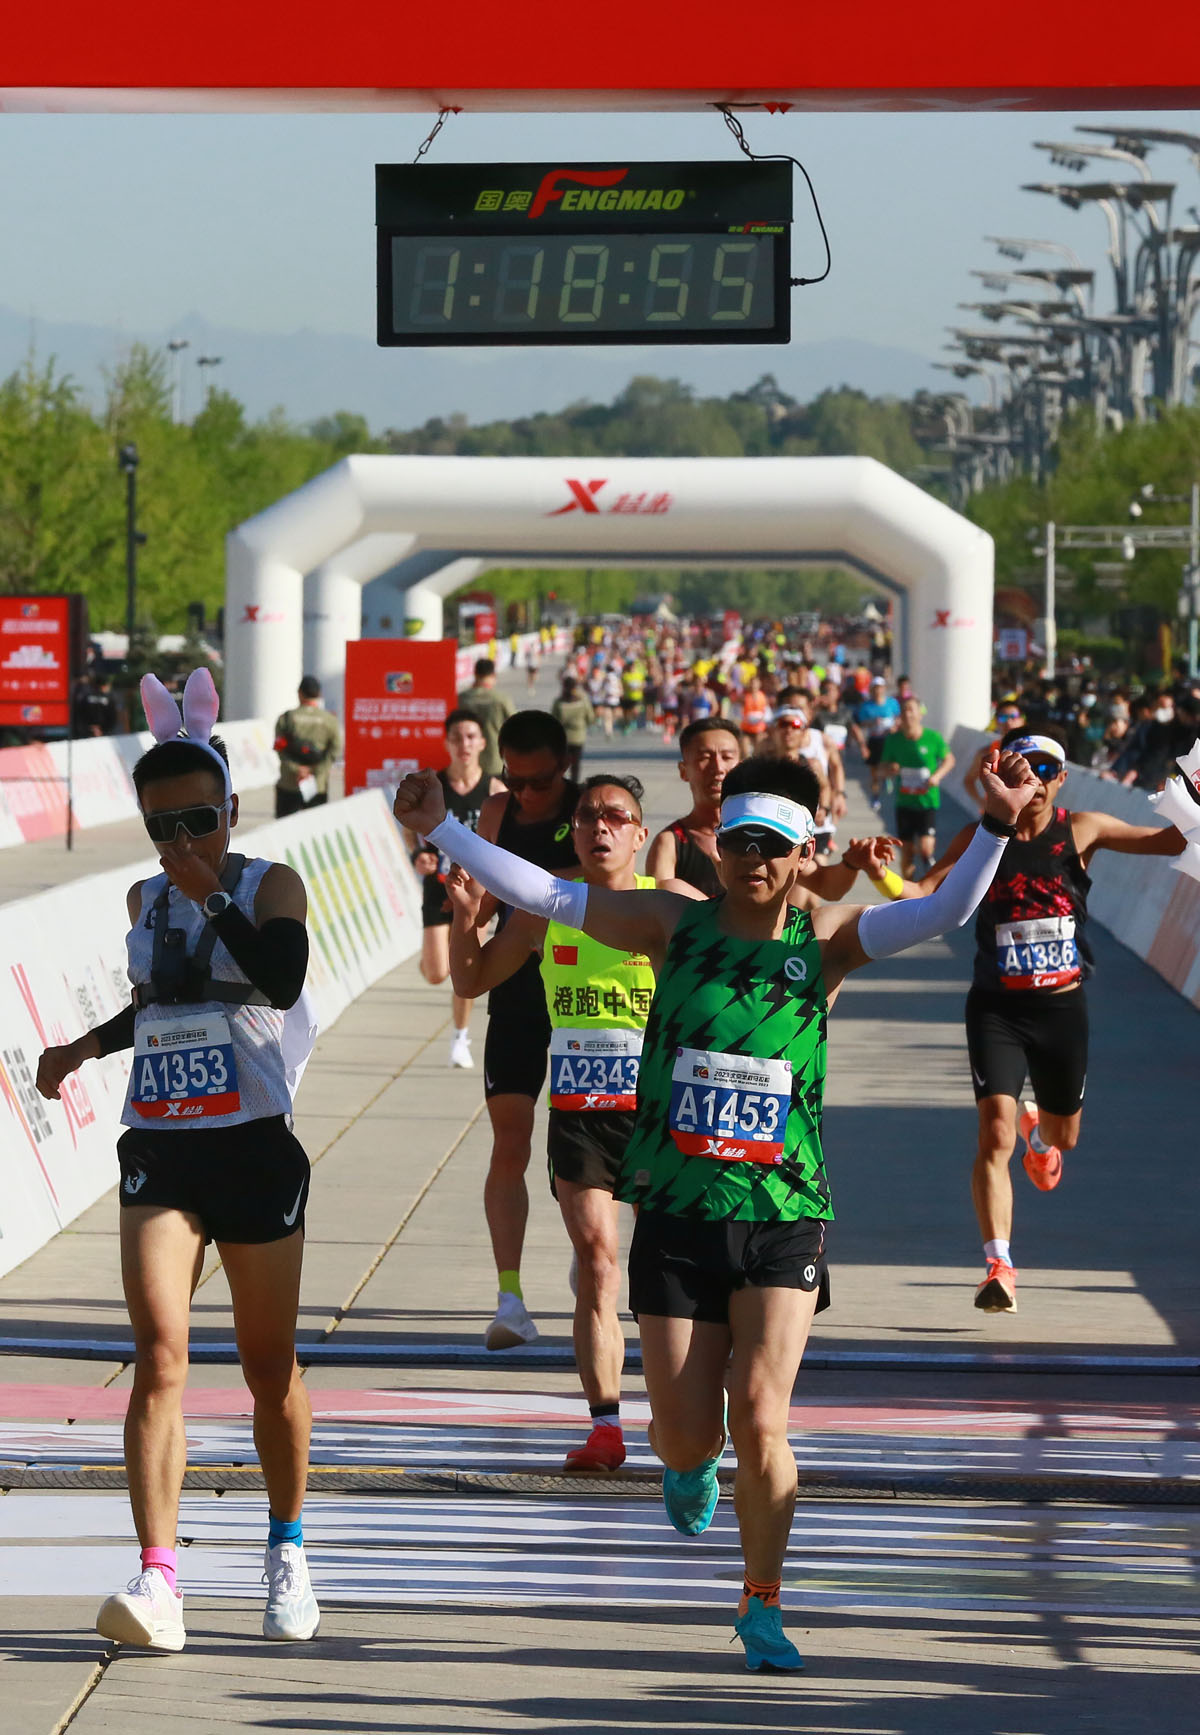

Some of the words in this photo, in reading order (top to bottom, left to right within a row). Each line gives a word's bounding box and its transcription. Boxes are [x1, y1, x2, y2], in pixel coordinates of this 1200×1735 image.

[474, 190, 532, 212] 国奥
[442, 243, 758, 321] 1:18:55
[1005, 940, 1075, 972] A1386
[553, 985, 652, 1018] 橙跑中国
[140, 1049, 228, 1095] A1353
[557, 1058, 640, 1088] A2343
[675, 1086, 780, 1134] A1453
